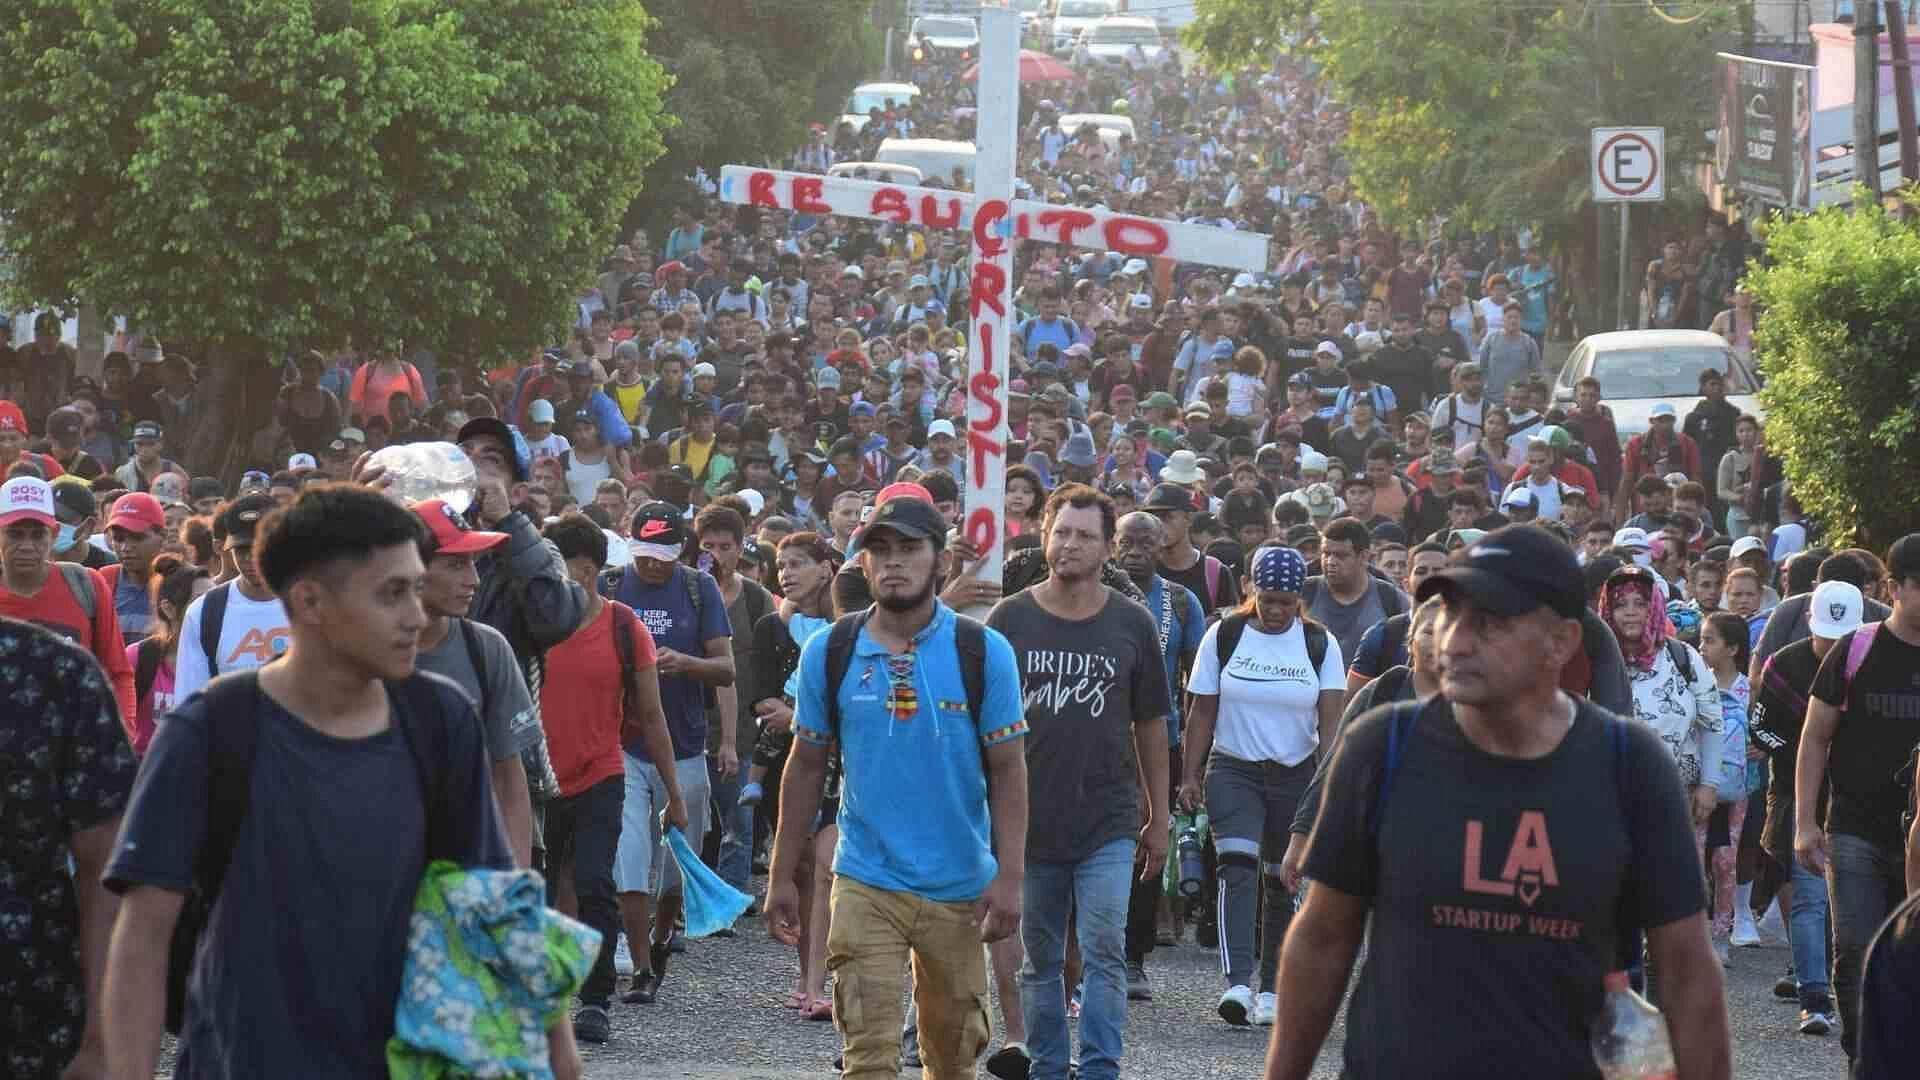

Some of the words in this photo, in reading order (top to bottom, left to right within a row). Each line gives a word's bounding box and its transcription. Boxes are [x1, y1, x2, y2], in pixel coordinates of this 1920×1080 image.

[1615, 145, 1642, 183] E
[748, 171, 832, 214] RE
[968, 200, 1010, 557] CRISTO
[10, 485, 46, 496] ROSY
[643, 609, 669, 617] KEEP
[648, 626, 667, 635] LUE
[1026, 650, 1117, 678] BRIDE'S
[1229, 656, 1309, 678] Awesome
[1463, 809, 1560, 896] LA
[1431, 903, 1521, 933] STARTUP
[1528, 912, 1584, 939] WEEK
